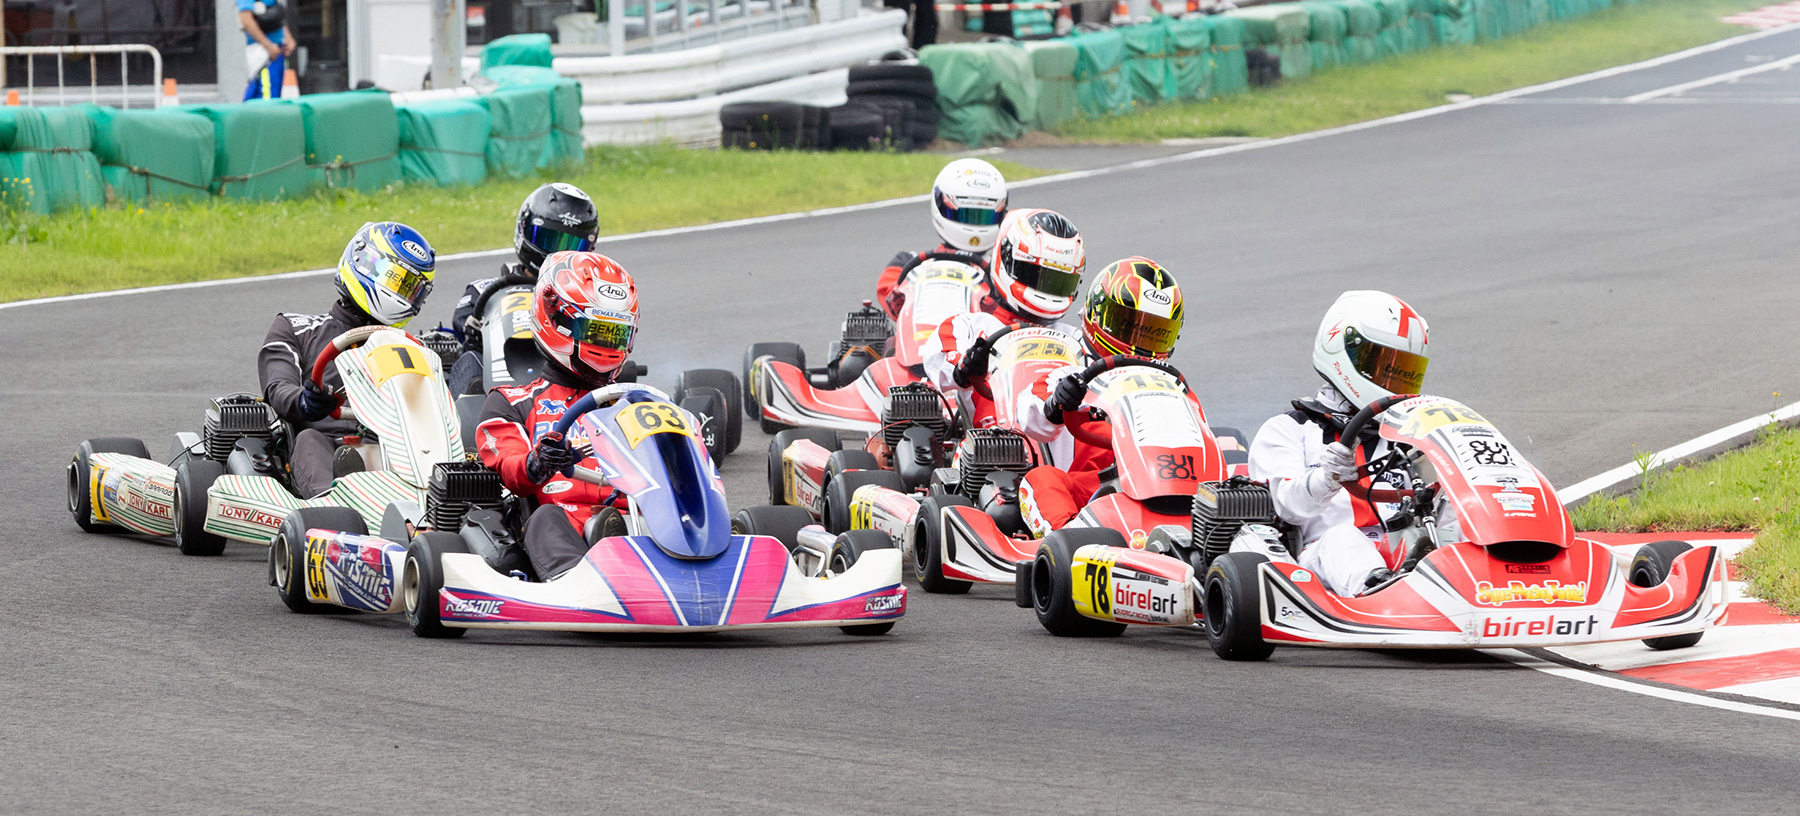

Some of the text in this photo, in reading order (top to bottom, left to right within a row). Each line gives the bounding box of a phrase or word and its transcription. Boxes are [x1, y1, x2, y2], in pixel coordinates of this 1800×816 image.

[408, 243, 425, 257] Arai
[604, 286, 625, 297] Arai
[1149, 290, 1168, 303] Arai
[592, 308, 615, 318] BEMAX
[588, 323, 628, 337] BEMAX
[1008, 329, 1069, 340] birelART
[392, 347, 415, 369] 1
[1017, 342, 1066, 359] 25
[1124, 374, 1176, 390] 15
[635, 404, 685, 431] 63
[1425, 407, 1485, 422] 78
[97, 468, 107, 518] 1
[257, 511, 284, 527] KAR
[1090, 550, 1115, 564] JAF
[308, 538, 328, 598] 63
[1085, 562, 1110, 615] 78
[445, 599, 505, 614] KOSMIC
[1115, 582, 1178, 615] birelart
[1482, 615, 1599, 638] birelart
